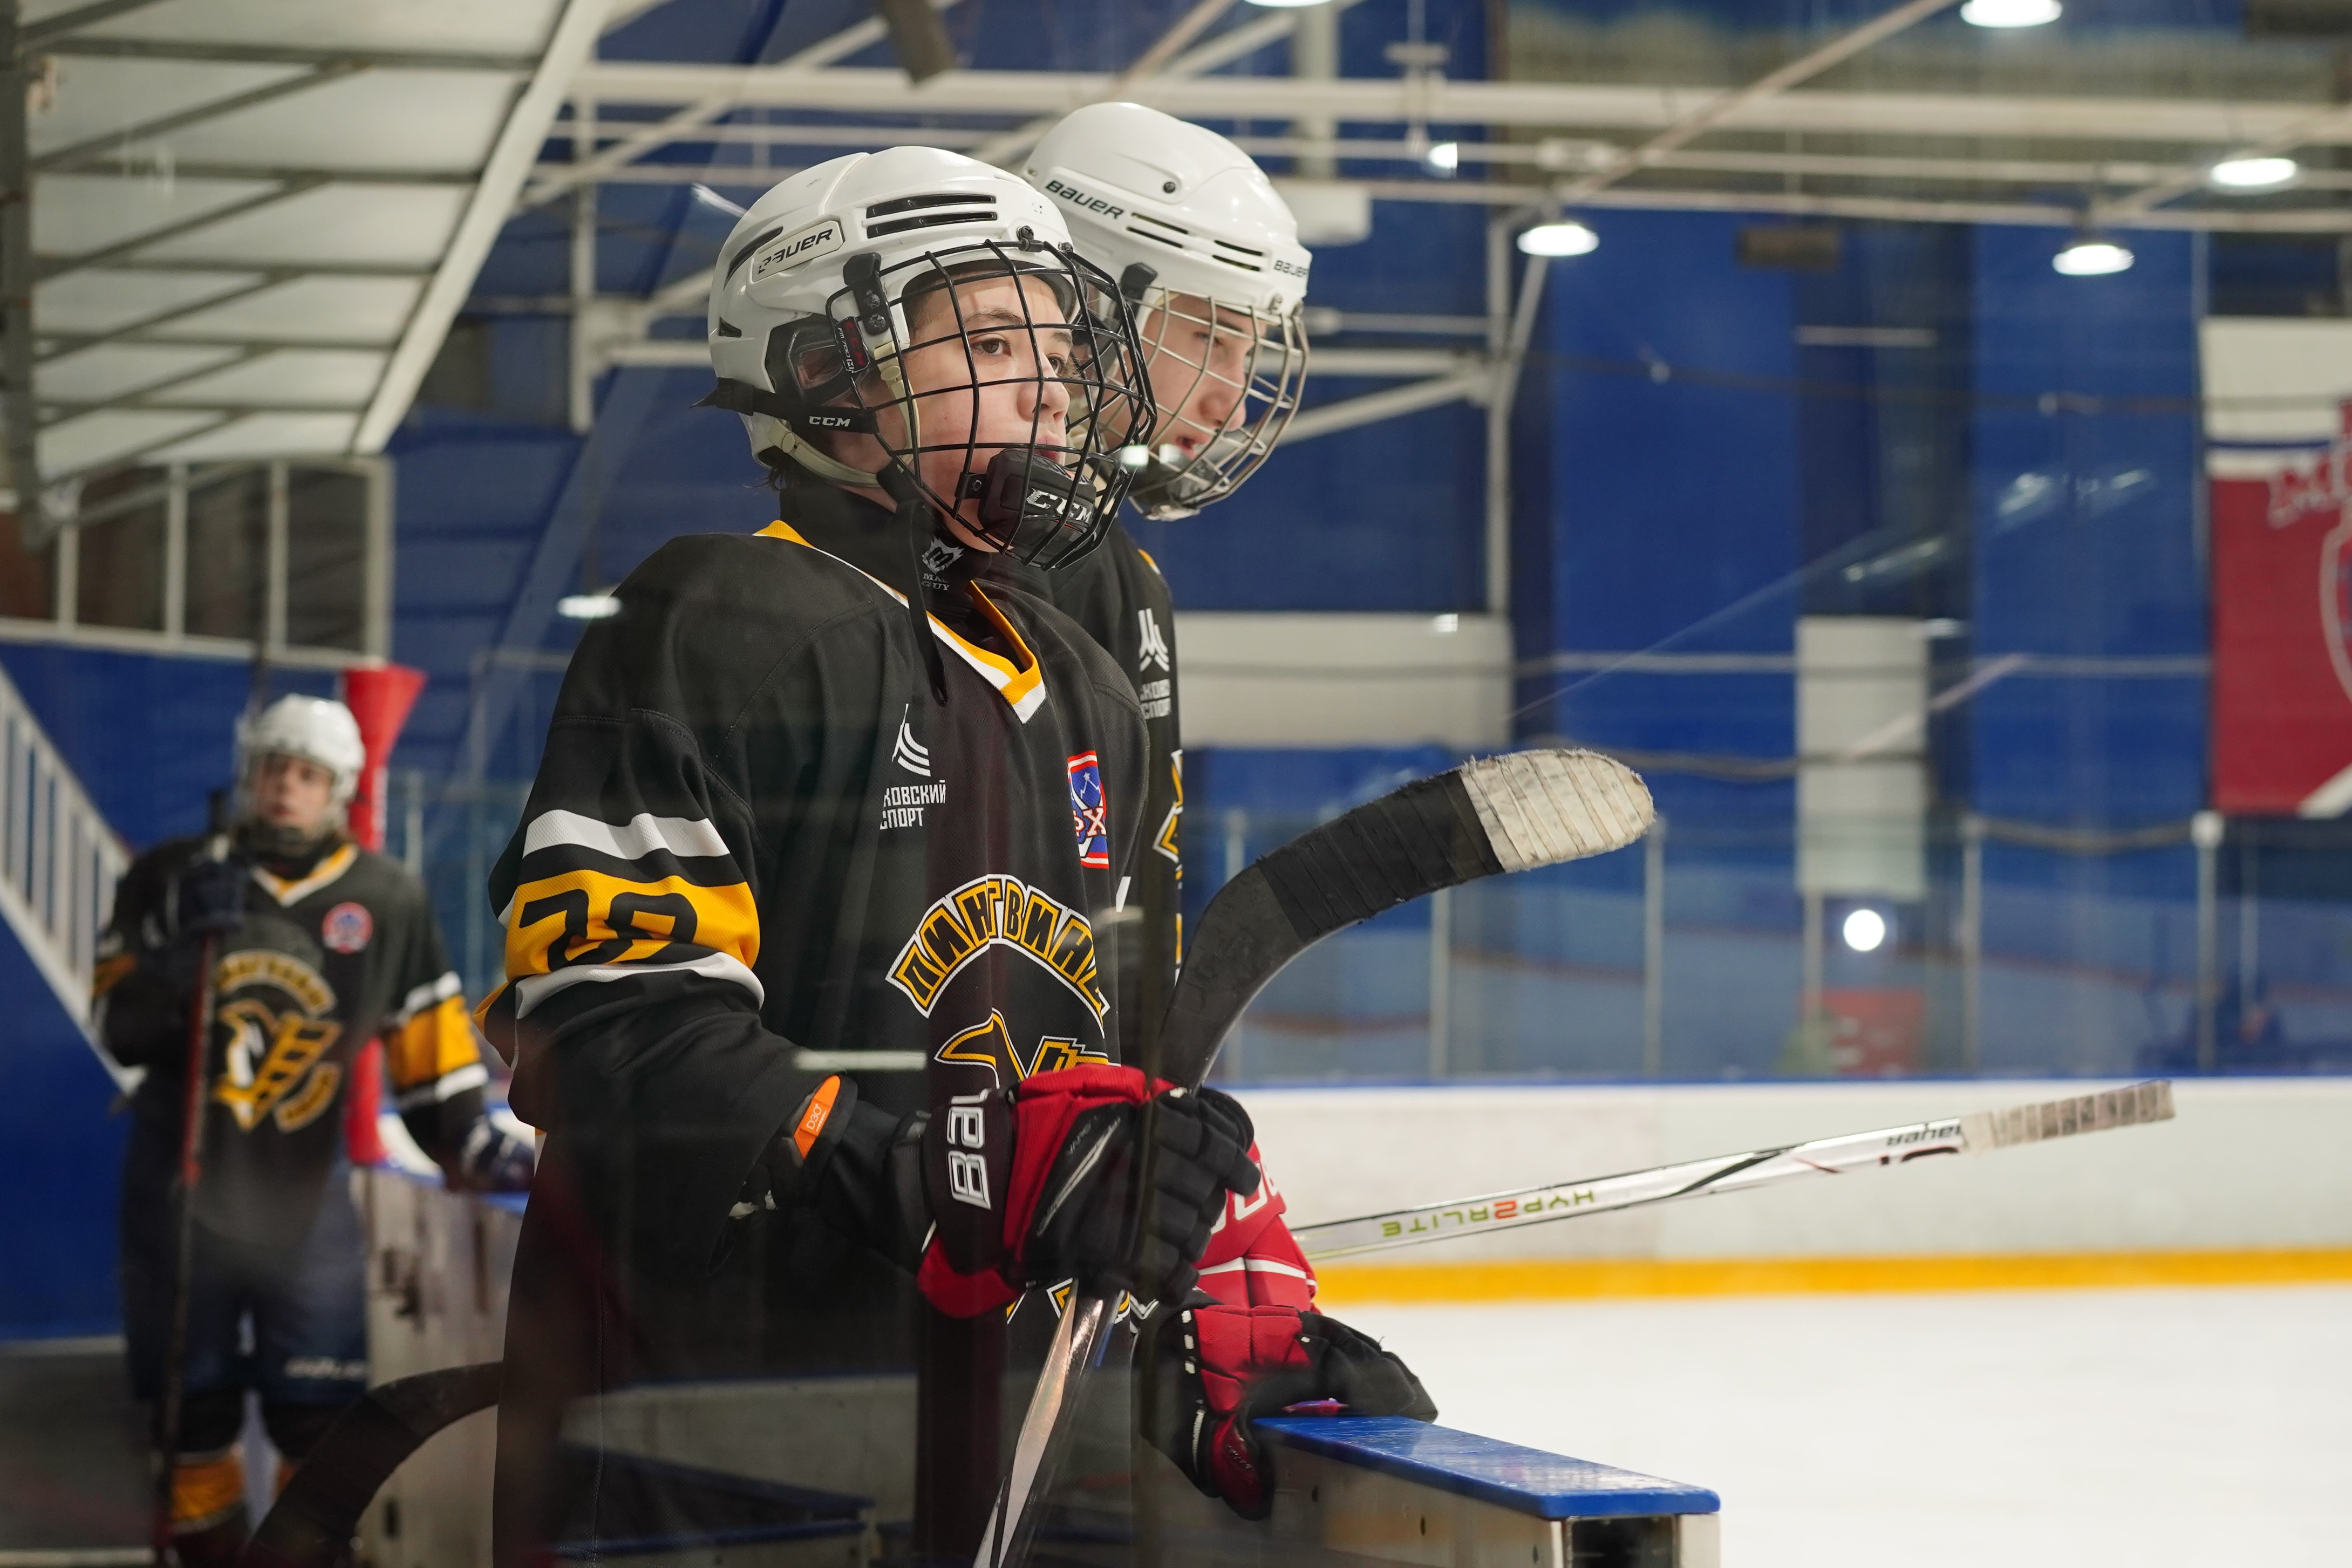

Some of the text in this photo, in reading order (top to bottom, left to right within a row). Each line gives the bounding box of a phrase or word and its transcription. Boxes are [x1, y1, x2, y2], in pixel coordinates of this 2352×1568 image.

[1045, 180, 1124, 219] BAUER
[758, 229, 833, 274] BAUER
[808, 415, 851, 427] CCM
[923, 573, 949, 583] MA
[921, 581, 950, 591] GUY
